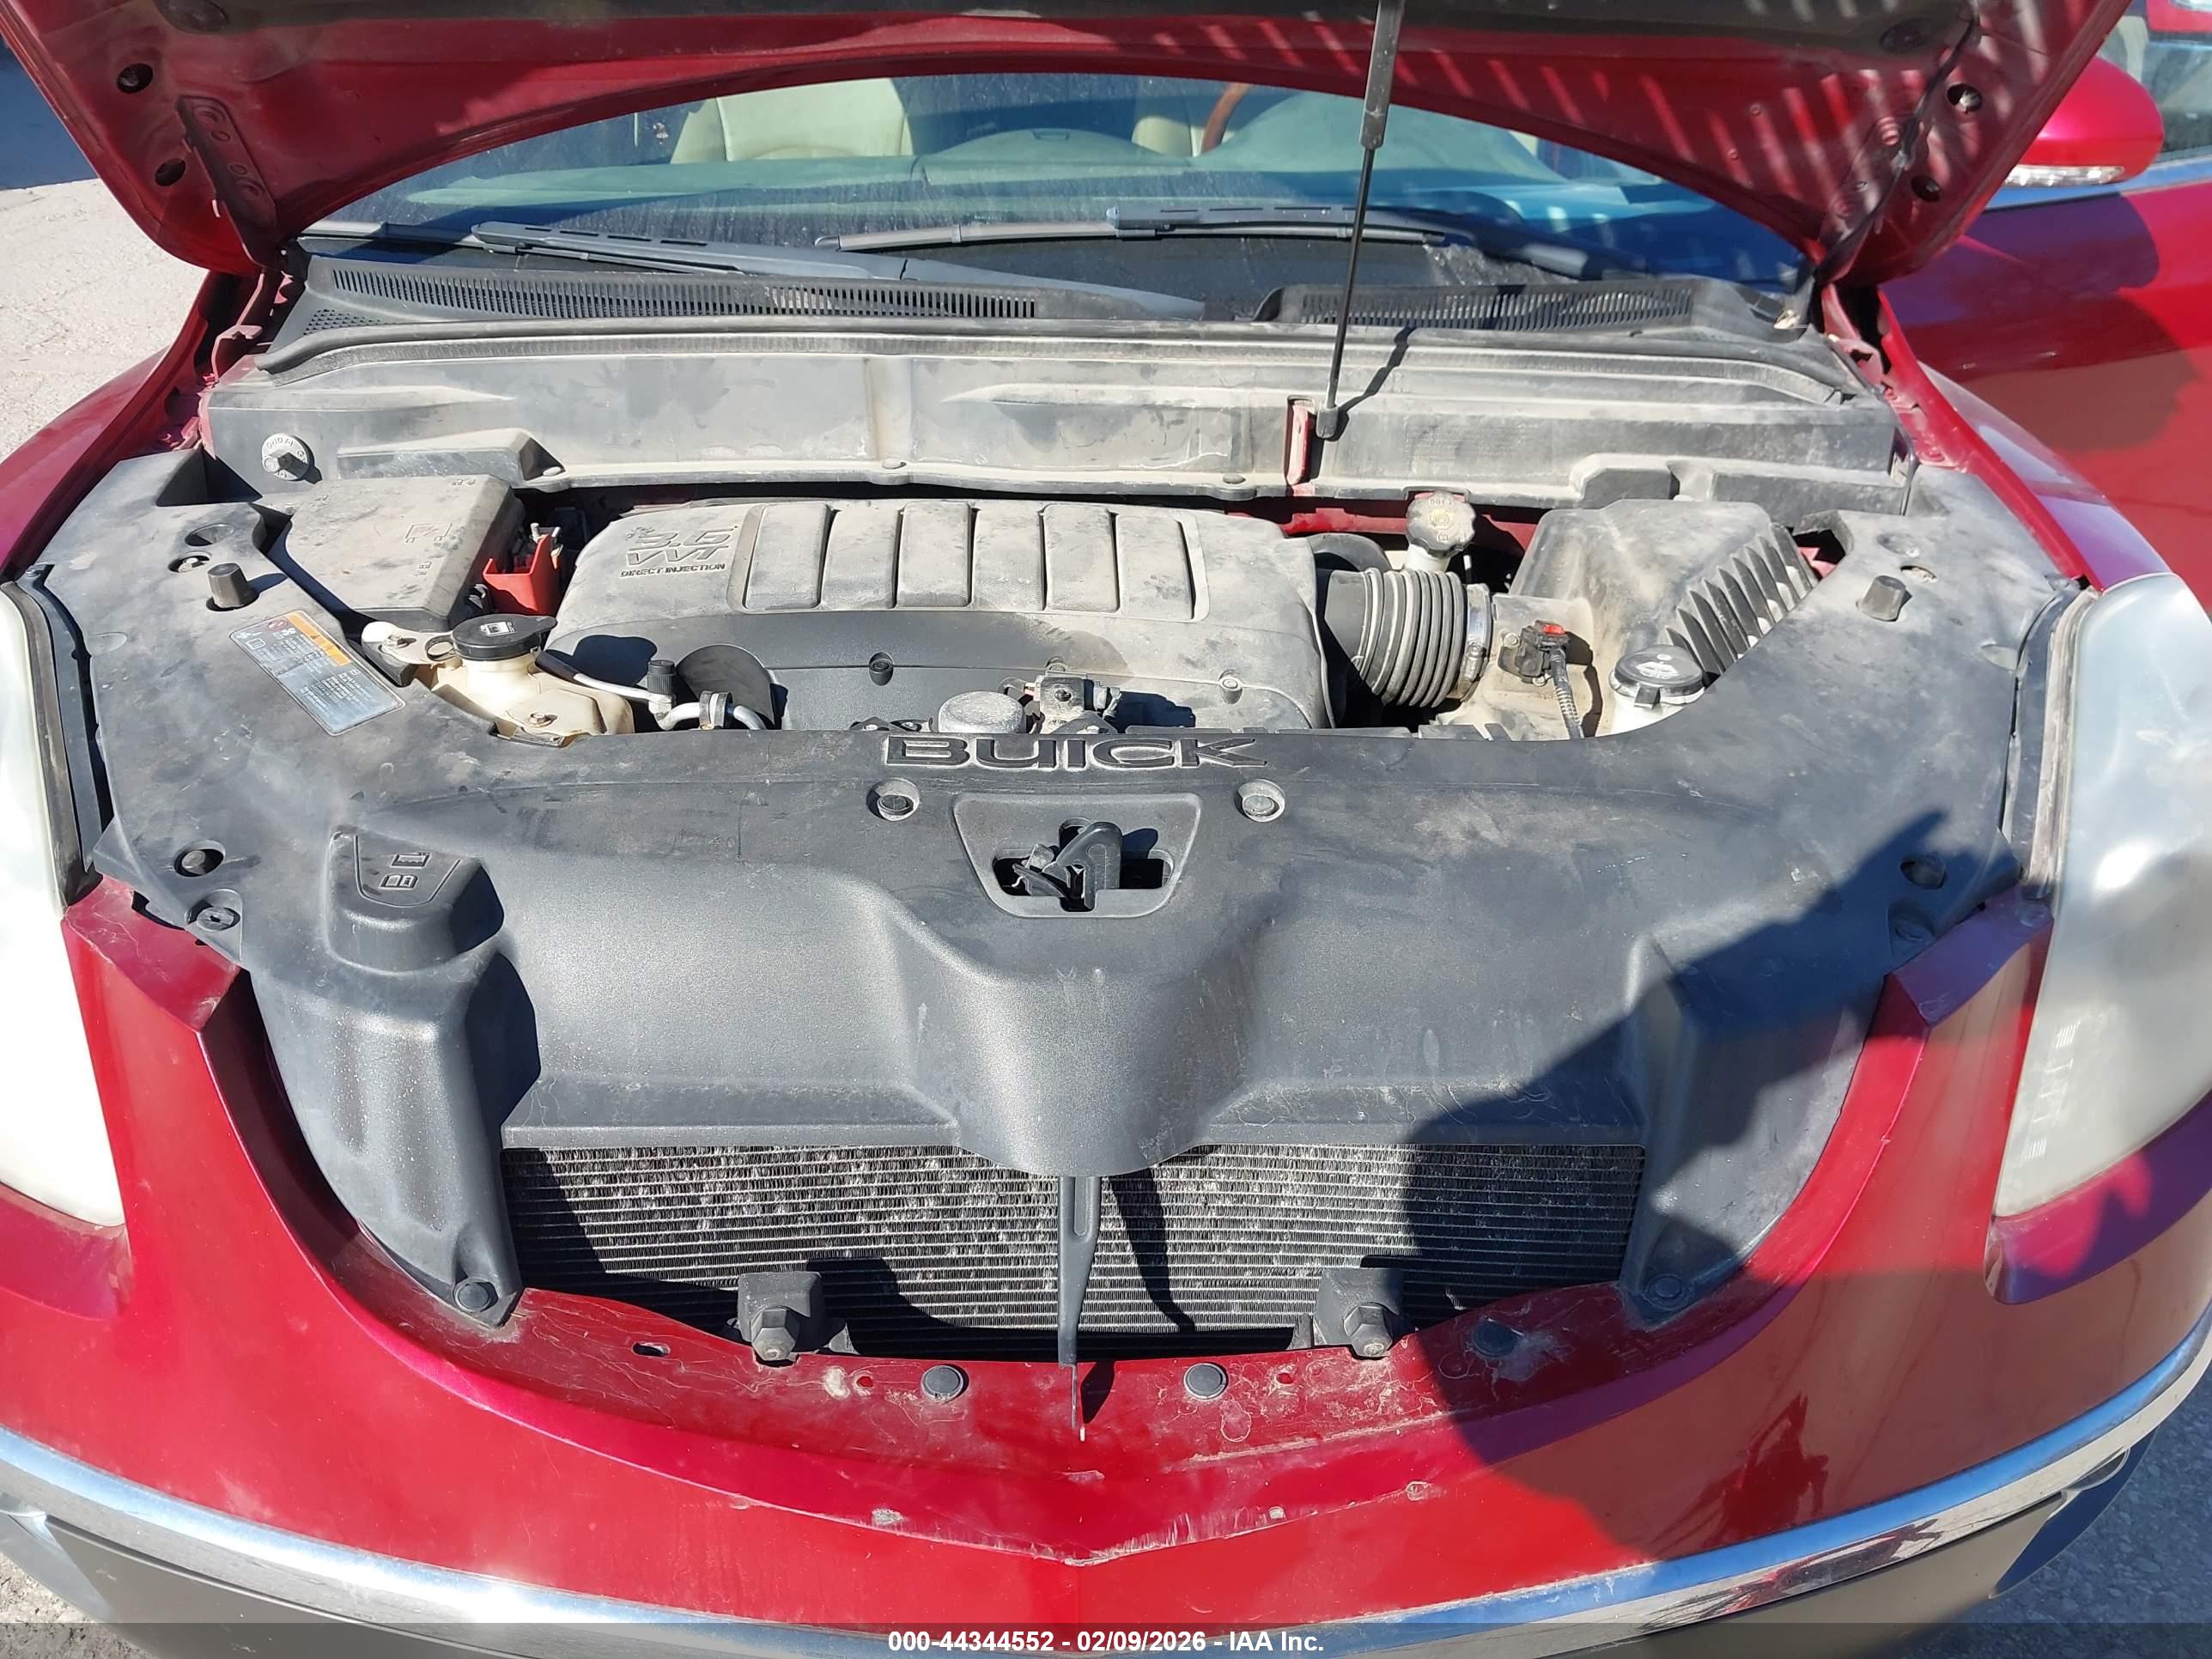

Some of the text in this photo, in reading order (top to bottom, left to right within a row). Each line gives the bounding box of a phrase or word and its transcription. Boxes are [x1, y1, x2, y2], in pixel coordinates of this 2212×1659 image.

[627, 545, 729, 566] VVT
[620, 562, 726, 578] DIRECT INJECTION
[885, 735, 1268, 770] BUICK
